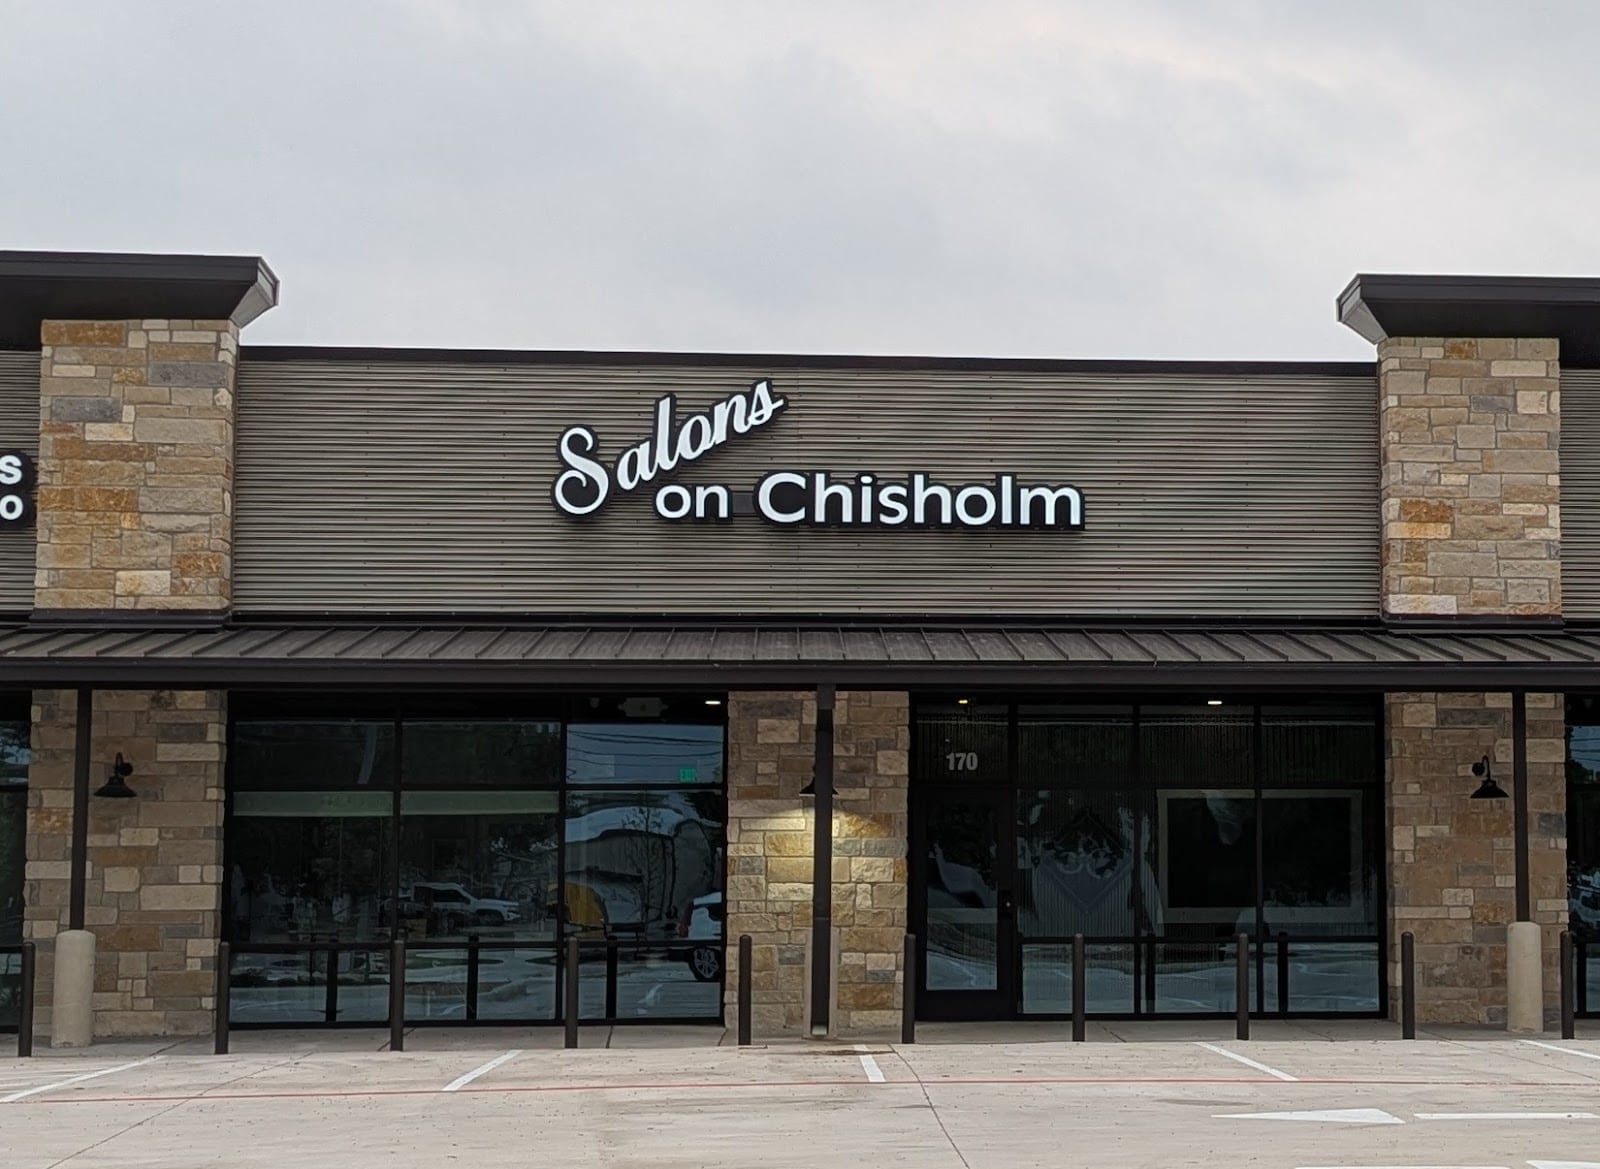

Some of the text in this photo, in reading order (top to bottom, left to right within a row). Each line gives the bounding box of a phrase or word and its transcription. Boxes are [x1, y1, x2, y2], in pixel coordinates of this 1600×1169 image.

[555, 380, 785, 515] Salons
[656, 472, 1081, 525] on Chisholm
[946, 752, 979, 771] 170
